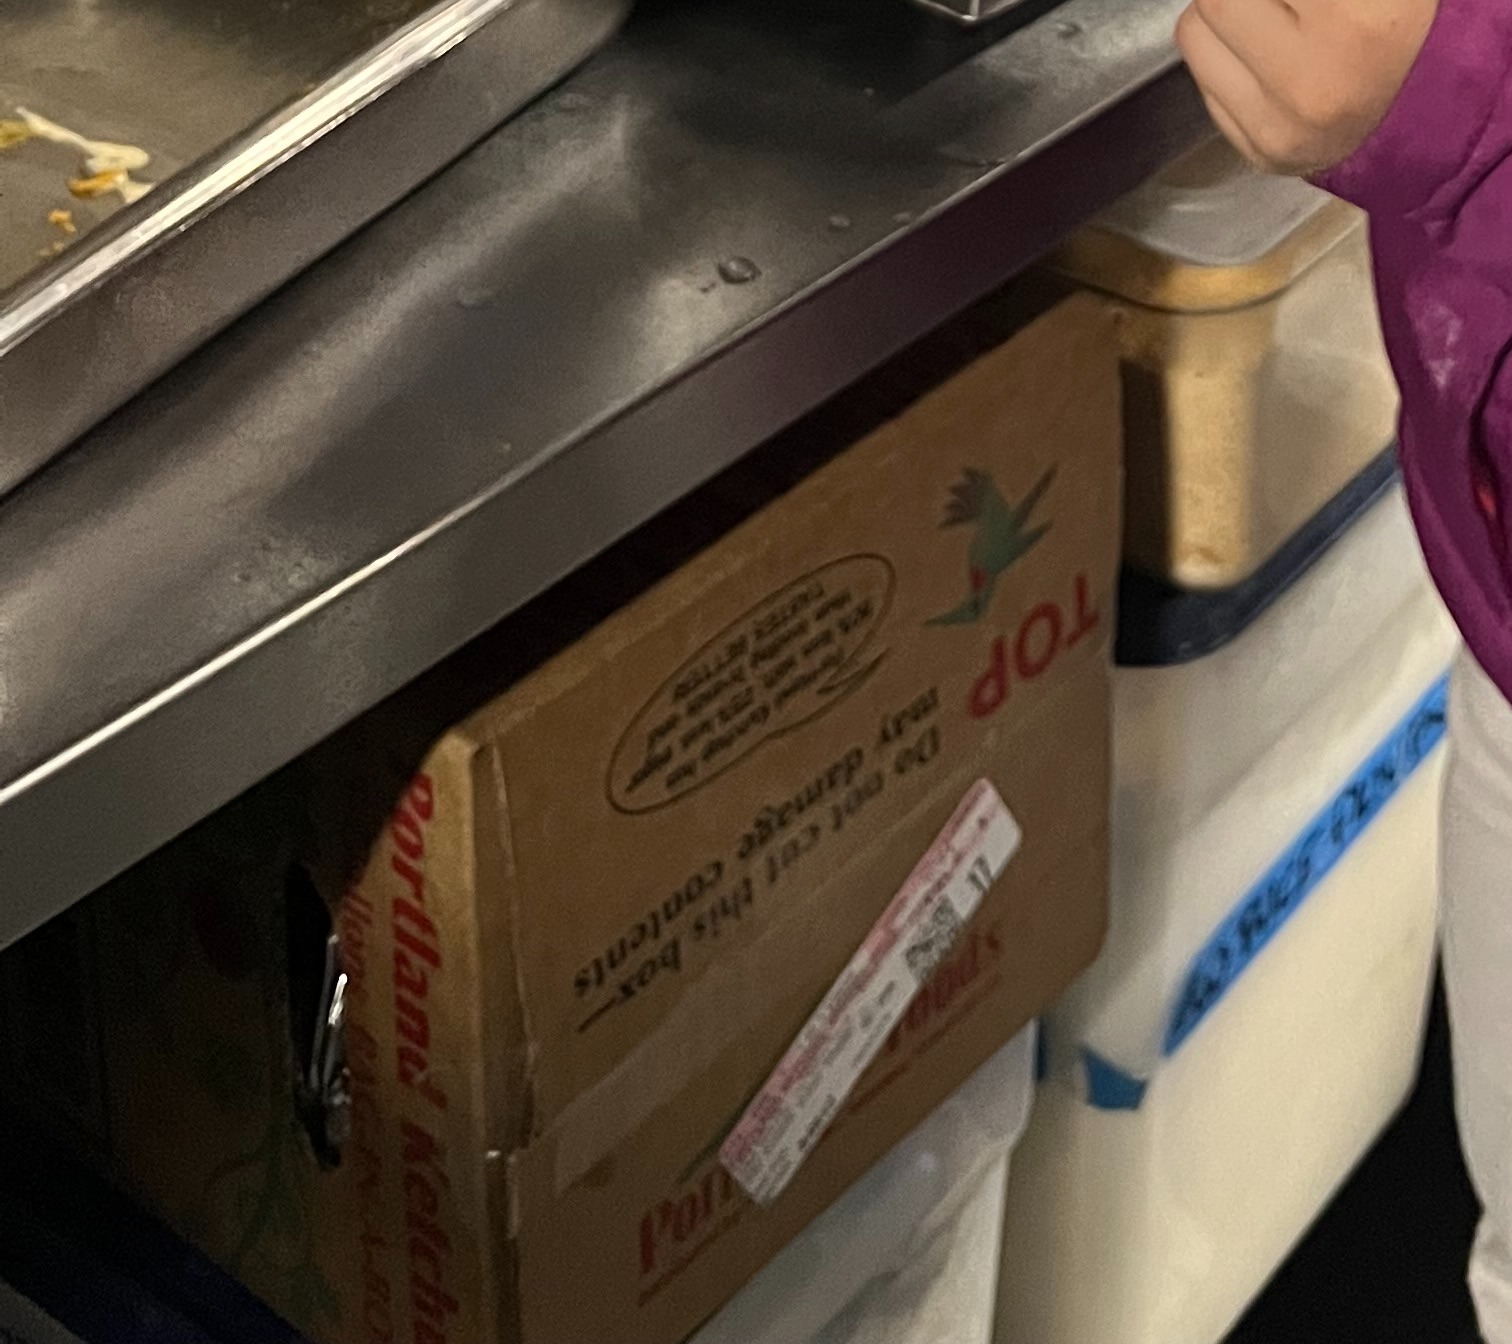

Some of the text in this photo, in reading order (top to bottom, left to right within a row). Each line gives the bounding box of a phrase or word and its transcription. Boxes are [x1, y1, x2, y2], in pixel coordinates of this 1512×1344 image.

[968, 573, 1100, 720] TOP
[893, 723, 941, 776] Do
[832, 769, 886, 832] not
[573, 685, 939, 998] may damage contents
[766, 823, 822, 885] cut
[693, 875, 754, 939] this
[392, 772, 443, 1109] Portland
